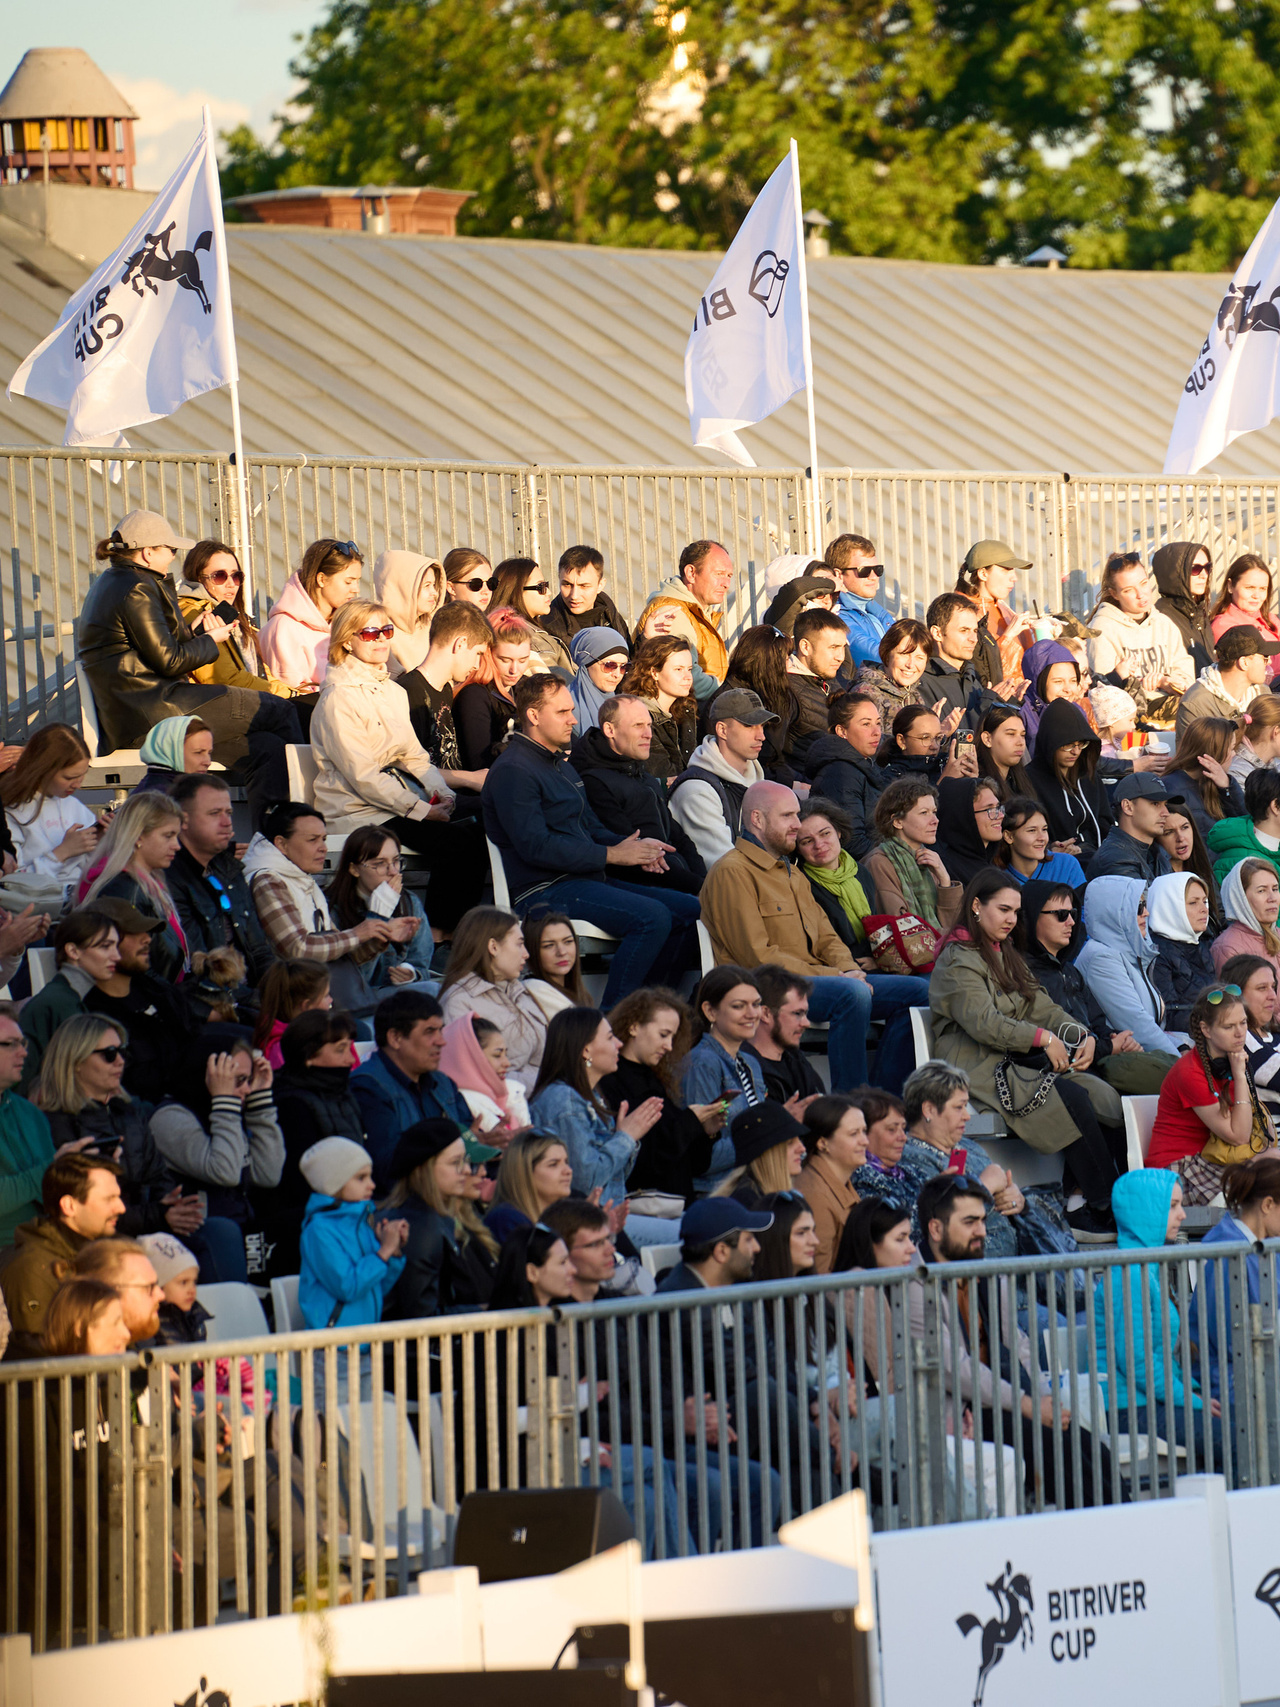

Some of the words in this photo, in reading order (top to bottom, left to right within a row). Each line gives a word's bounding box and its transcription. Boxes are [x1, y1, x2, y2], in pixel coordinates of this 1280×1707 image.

[244, 1233, 262, 1276] PUMA
[1048, 1580, 1146, 1622] BITRIVER
[1050, 1627, 1096, 1663] CUP
